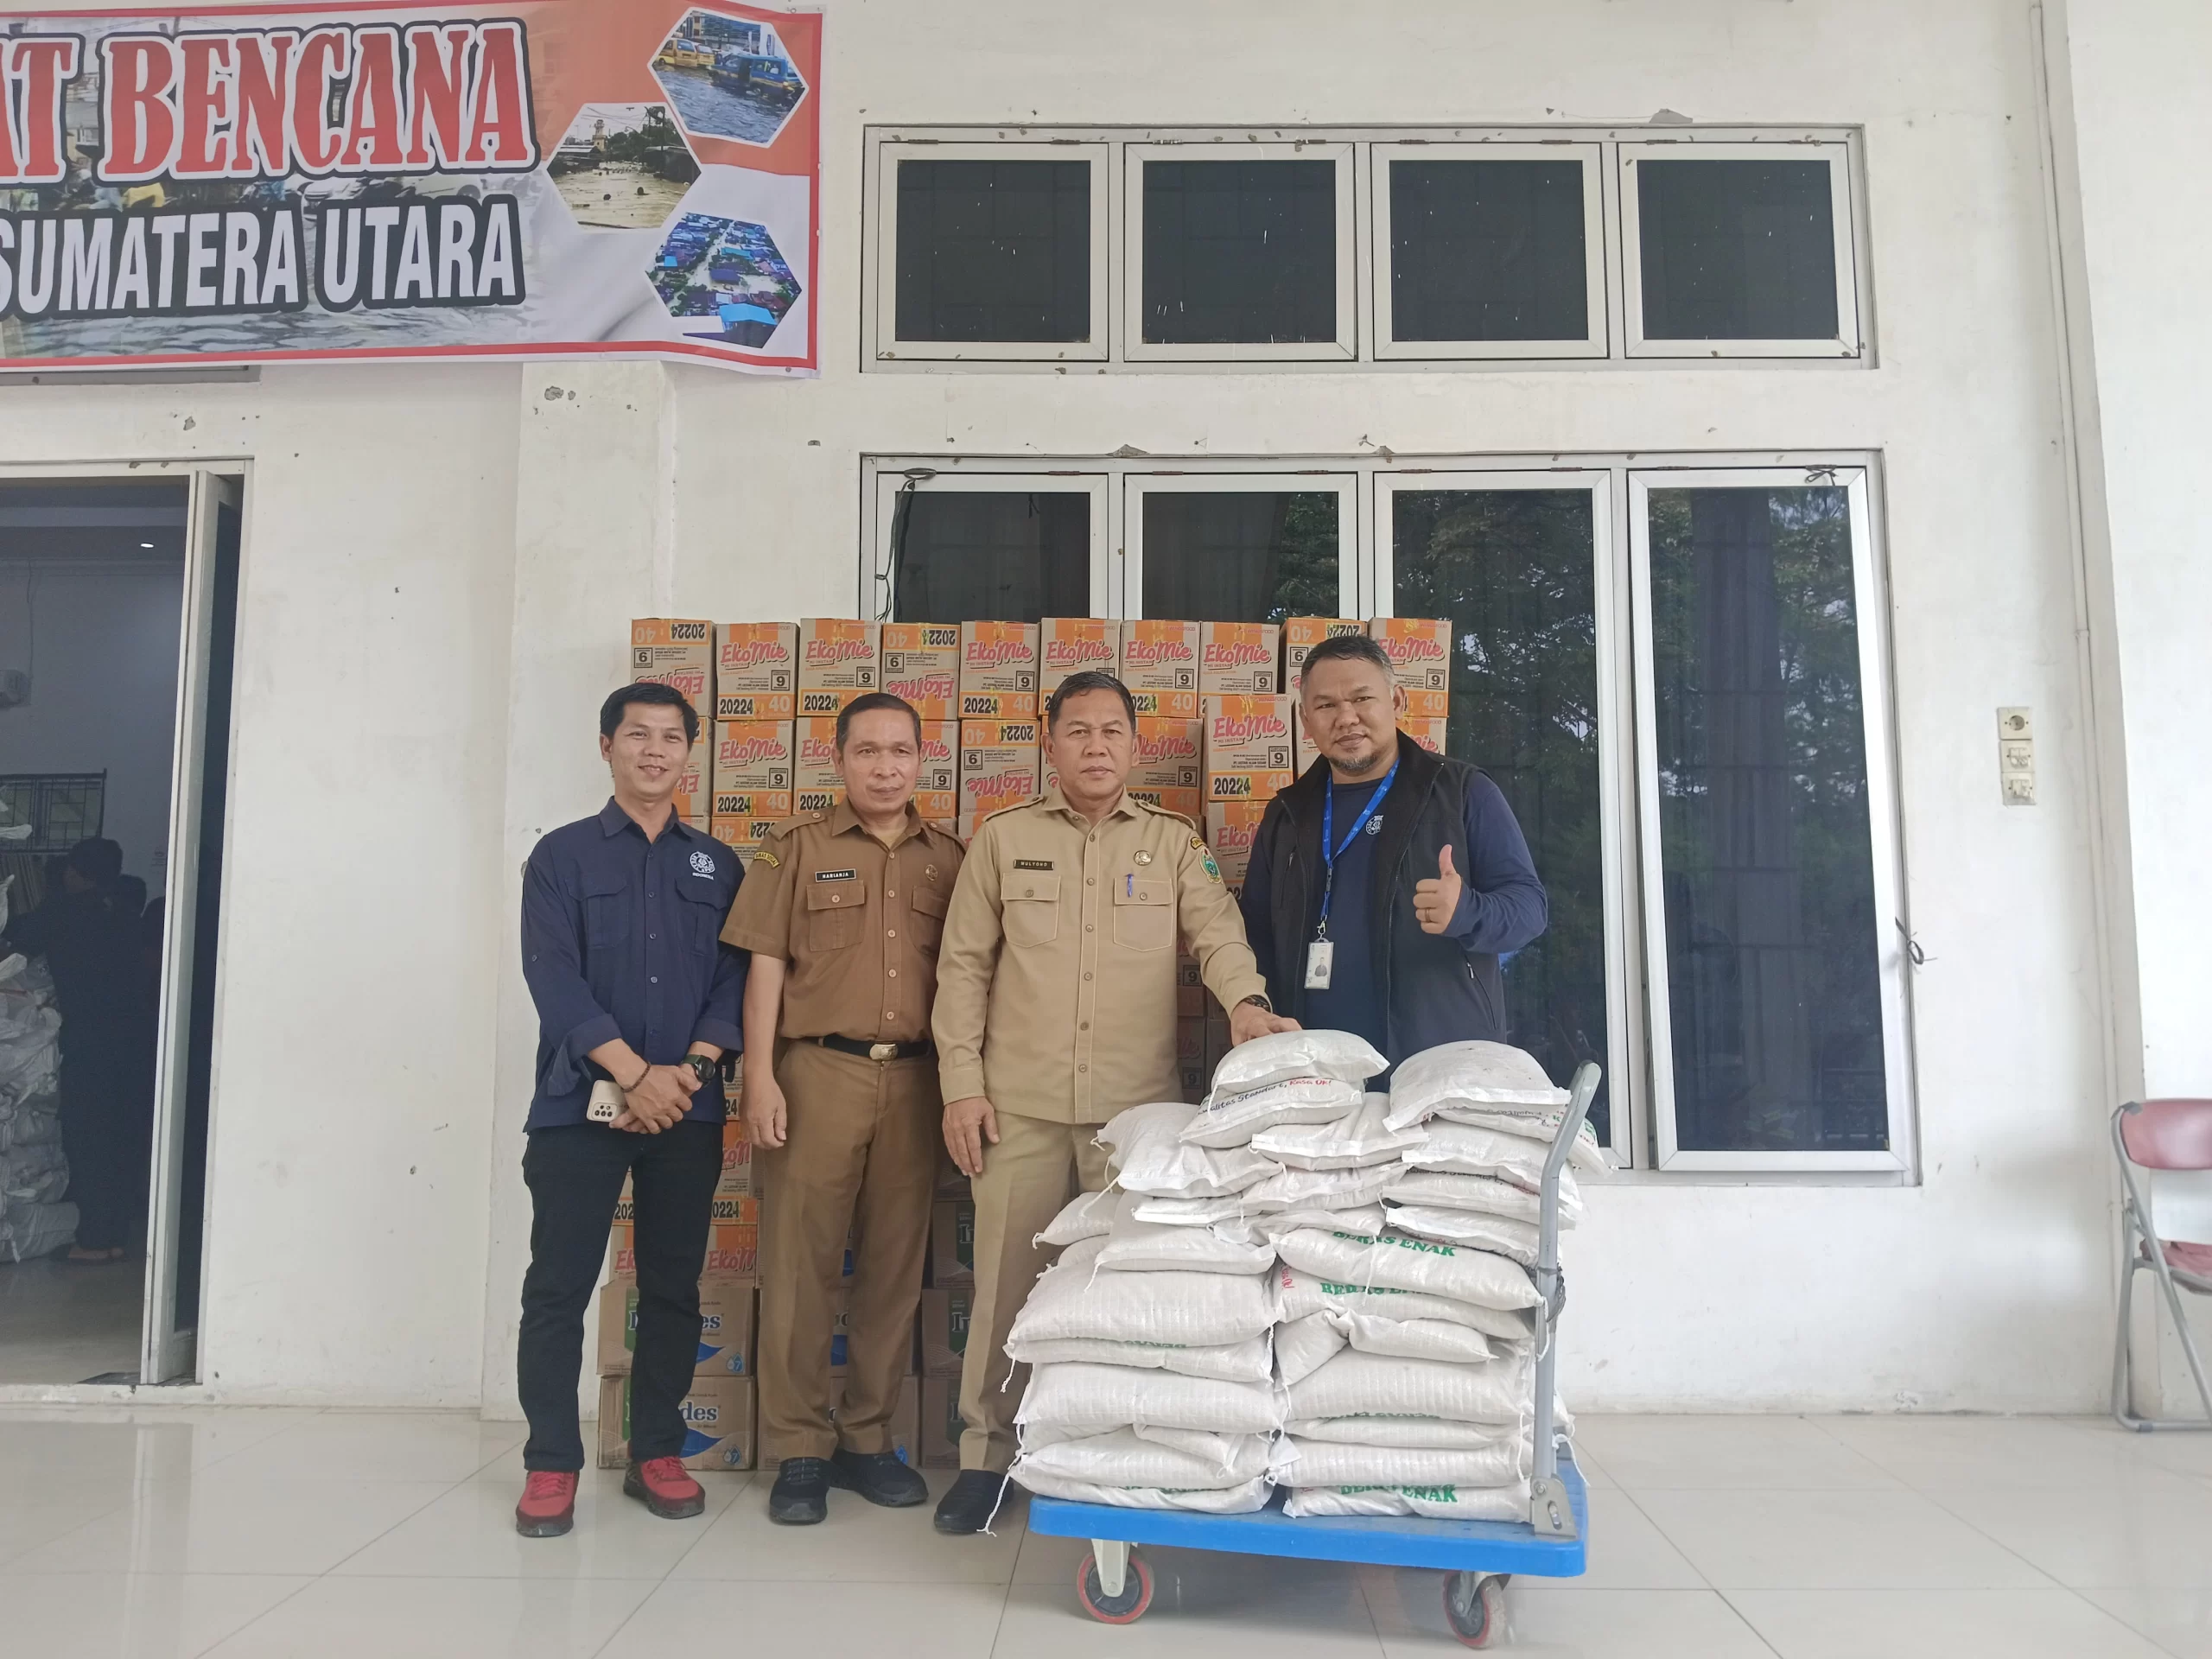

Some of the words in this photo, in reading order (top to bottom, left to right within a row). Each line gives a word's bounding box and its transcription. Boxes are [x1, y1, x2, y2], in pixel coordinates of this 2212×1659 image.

[105, 28, 527, 175] BENCANA
[323, 203, 516, 302] UTARA
[671, 623, 705, 639] 20224
[720, 641, 788, 664] EkoMie
[805, 639, 874, 661] EkoMie
[966, 639, 1033, 663] EkoMie
[1046, 639, 1112, 662] EkoMie
[1125, 640, 1192, 662] EkoMie
[1204, 643, 1270, 665] EkoMie
[776, 676, 785, 687] 9
[861, 672, 871, 683] 9
[1020, 677, 1030, 688] 9
[1180, 674, 1189, 685] 9
[1258, 677, 1268, 688] 9
[1431, 674, 1440, 685] 9
[720, 698, 753, 715] 20224
[768, 696, 791, 712] 40
[963, 697, 998, 714] 20224
[1013, 696, 1033, 712] 40
[1133, 696, 1157, 712] 0224
[1172, 694, 1193, 710] 40
[1423, 694, 1444, 710] 40
[1001, 725, 1033, 741] 20224
[1213, 714, 1285, 739] EkoMie
[719, 737, 785, 760] EkoMie
[1137, 734, 1195, 758] koMie
[1274, 752, 1284, 764] 9
[774, 774, 784, 785] 9
[938, 775, 947, 786] 9
[1183, 772, 1193, 783] 9
[1214, 778, 1251, 795] 20224
[1267, 773, 1289, 791] 40
[968, 778, 1033, 798] EkoMie
[717, 797, 751, 813] 20224
[766, 793, 788, 810] 40
[799, 795, 834, 810] 20224
[931, 794, 951, 810] 40
[1188, 970, 1198, 982] 9
[614, 1204, 633, 1220] 202
[712, 1201, 739, 1217] 0224
[1399, 1238, 1456, 1257] ENAK
[1402, 1484, 1457, 1503] ENAK
